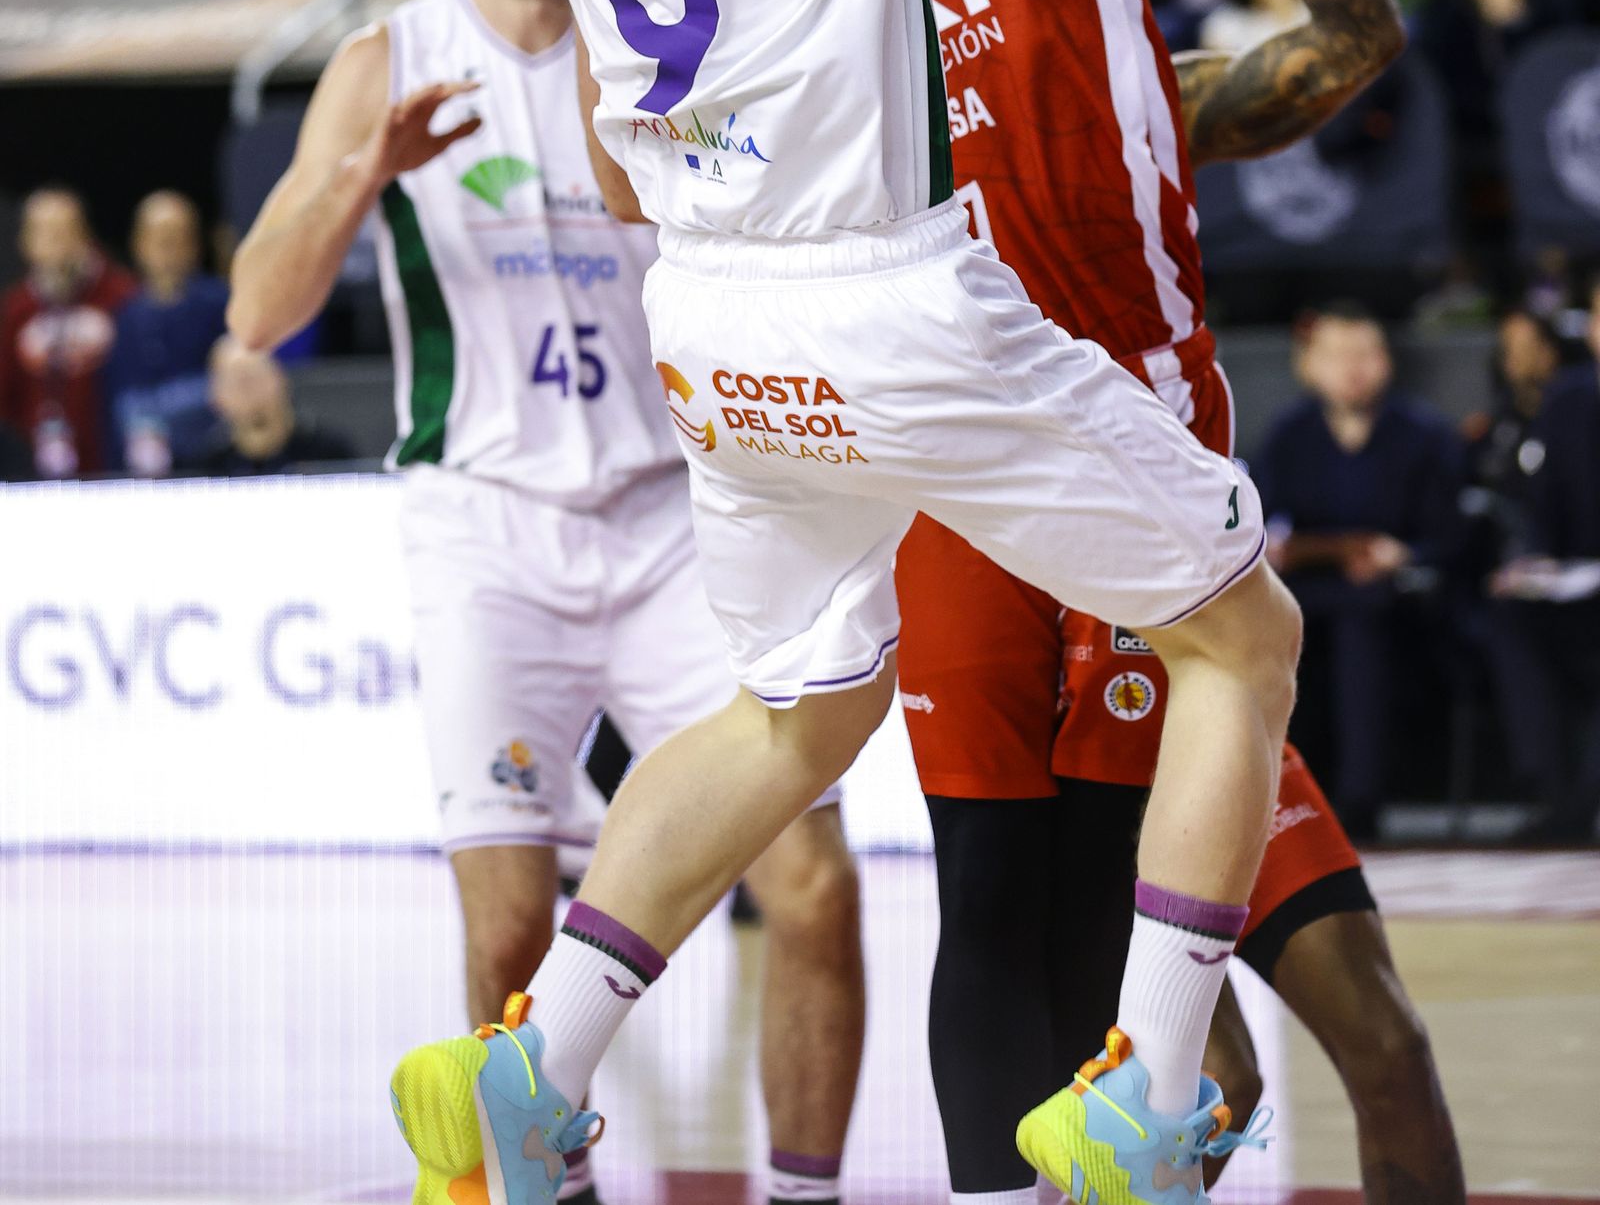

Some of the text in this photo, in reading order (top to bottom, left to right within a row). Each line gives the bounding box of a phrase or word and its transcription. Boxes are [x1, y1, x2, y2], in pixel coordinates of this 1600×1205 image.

[627, 108, 773, 163] Andalucía
[531, 324, 607, 401] 45
[712, 369, 847, 407] COSTA
[721, 407, 857, 438] DEL SOL
[735, 432, 870, 464] MÁLAGA
[7, 601, 421, 707] GVC Ga
